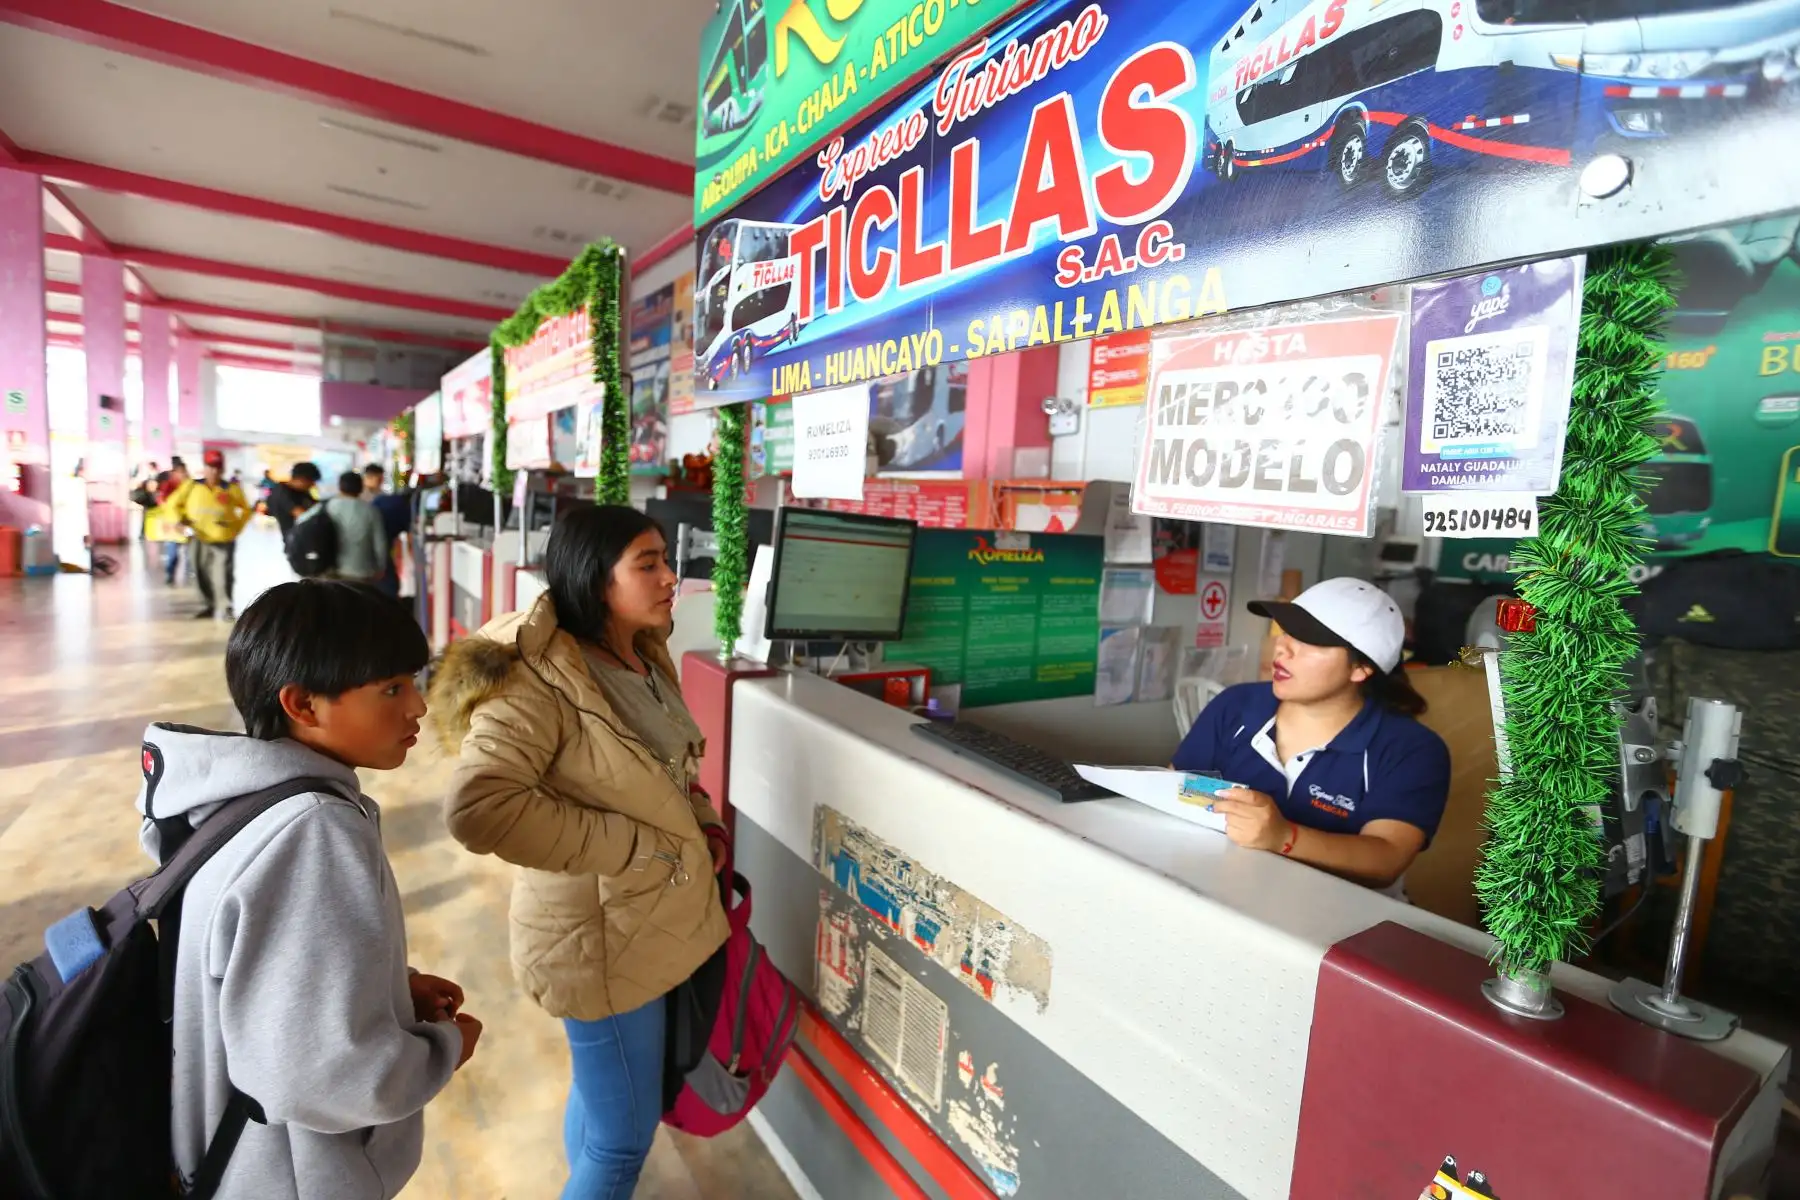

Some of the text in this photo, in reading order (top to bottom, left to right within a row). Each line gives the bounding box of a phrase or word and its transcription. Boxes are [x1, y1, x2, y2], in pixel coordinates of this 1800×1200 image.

[765, 118, 789, 163] ICA
[796, 61, 857, 134] CHALA
[870, 0, 945, 80] ATICO
[818, 110, 927, 201] Expreso
[934, 5, 1108, 135] Turismo
[788, 43, 1195, 325] TICLLAS
[753, 264, 795, 288] TICLLAS
[1056, 221, 1186, 288] S.A.C.
[772, 360, 811, 396] LIMA
[826, 329, 942, 384] HUANCAYO
[967, 268, 1229, 357] SAPALLANGA
[1464, 290, 1510, 333] yape
[806, 419, 852, 438] ROMELIZA
[1148, 438, 1365, 496] MODELO
[1421, 461, 1462, 473] NATALY
[1431, 474, 1477, 485] DAMIAN
[1273, 511, 1358, 529] ANGARAES
[1424, 508, 1532, 532] 925101484
